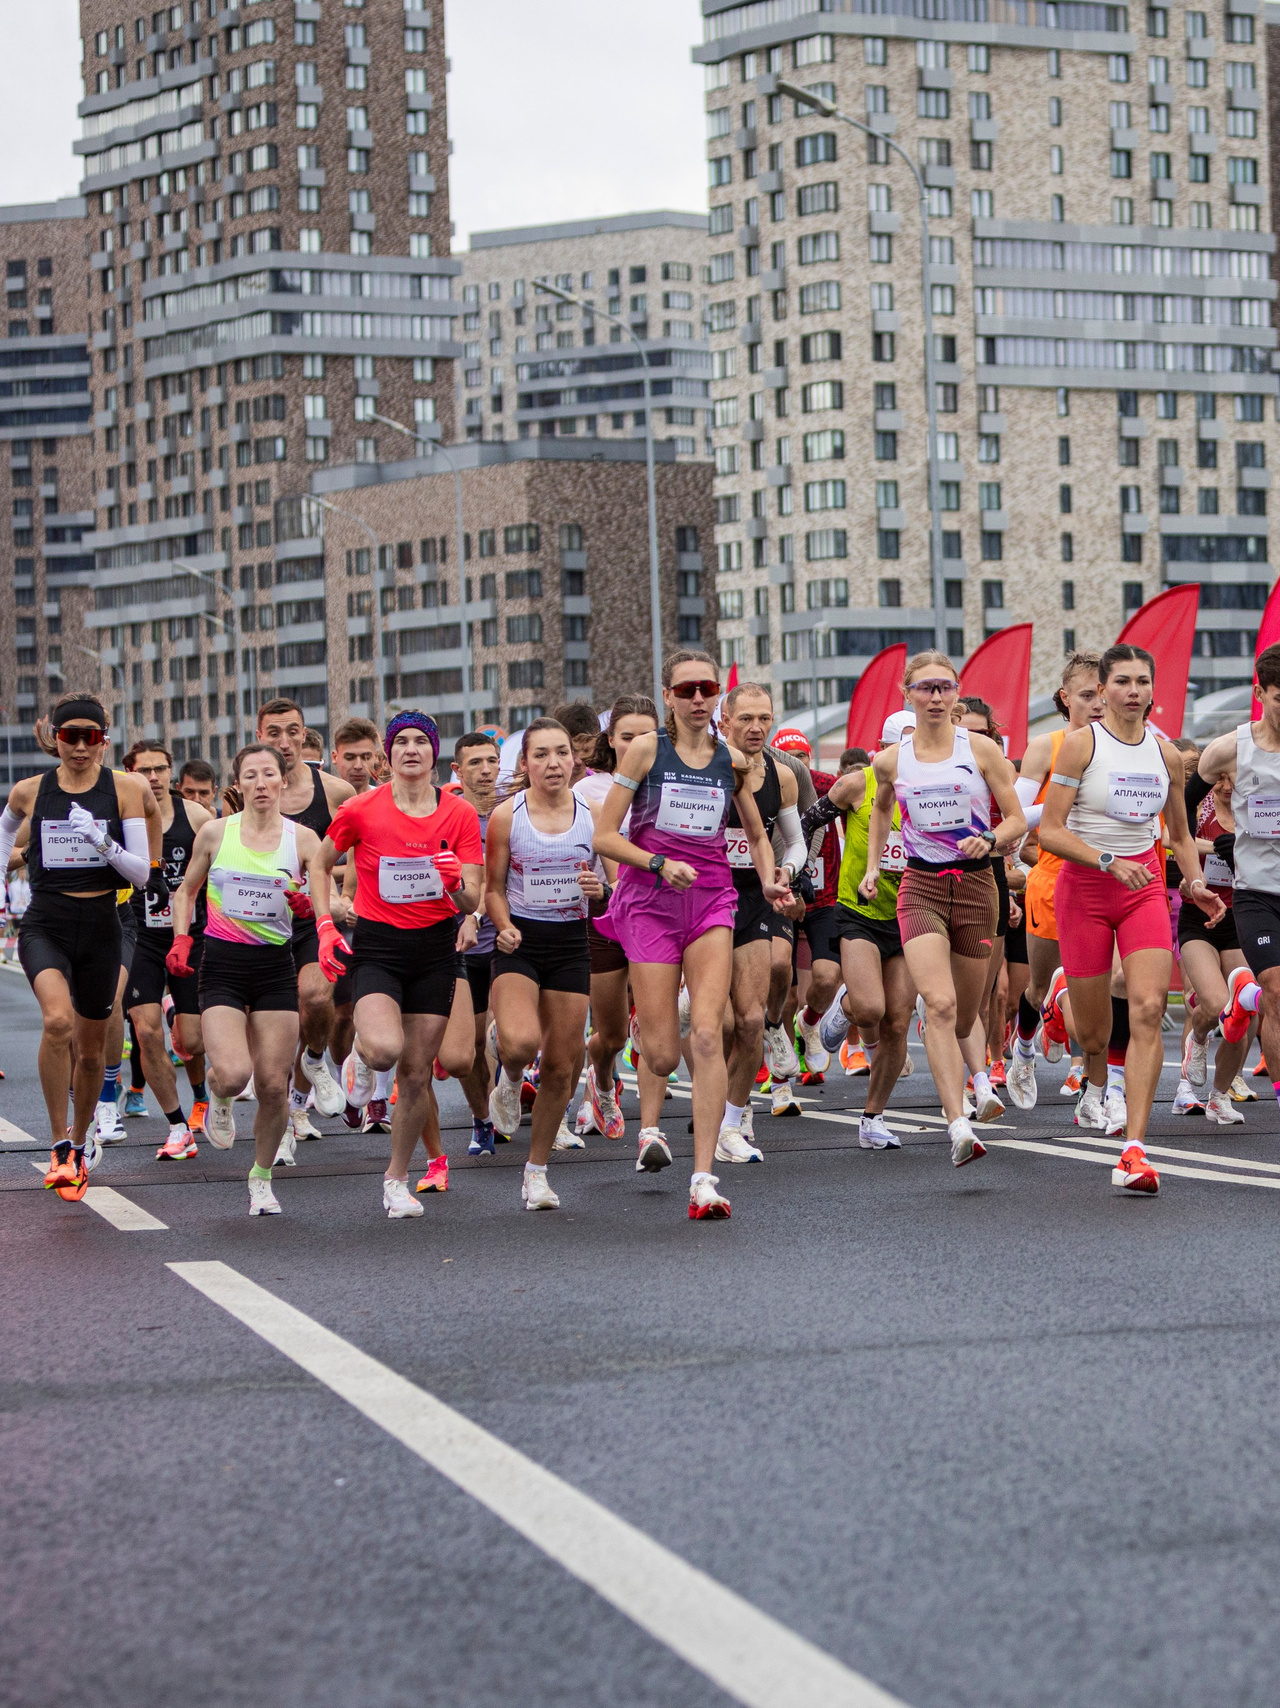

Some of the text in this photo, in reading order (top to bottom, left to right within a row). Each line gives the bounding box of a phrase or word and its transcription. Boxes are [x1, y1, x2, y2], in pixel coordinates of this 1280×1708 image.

[1114, 789, 1162, 799] АПЛАЧКИНА
[670, 800, 716, 812] БЫШКИНА
[919, 800, 958, 809] МОКИНА
[727, 840, 749, 854] 76
[238, 889, 272, 899] БУРЗАК
